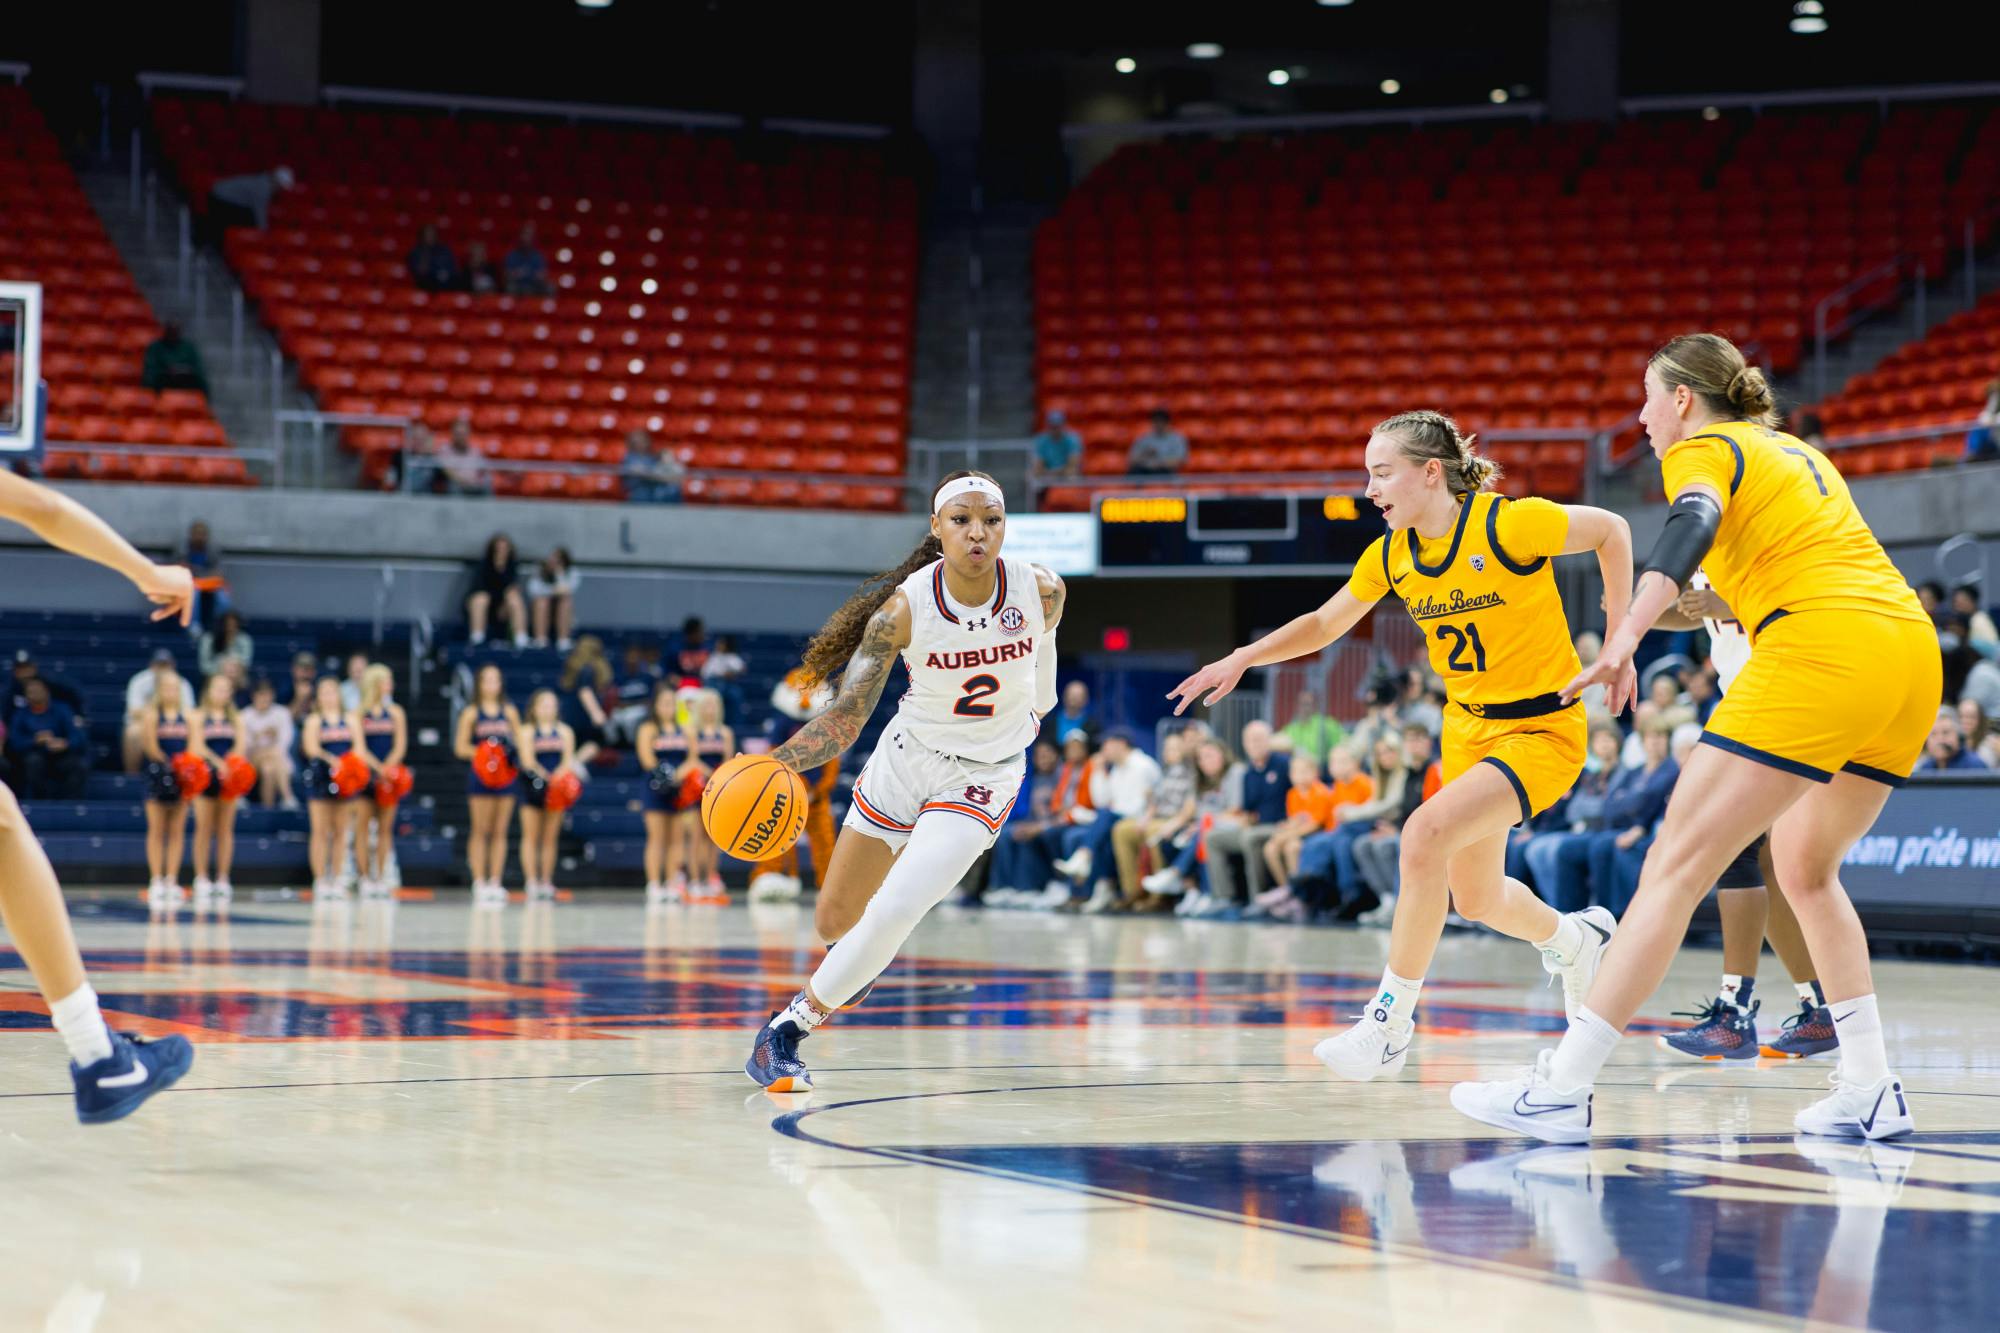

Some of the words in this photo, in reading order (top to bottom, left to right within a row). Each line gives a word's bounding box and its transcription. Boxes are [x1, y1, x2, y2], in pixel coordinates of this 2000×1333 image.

[1780, 447, 1828, 496] 7
[1449, 588, 1501, 611] Bears
[926, 637, 1033, 670] AUBURN
[1436, 622, 1486, 672] 21
[953, 673, 1001, 717] 2
[739, 793, 787, 855] Wilson
[1894, 826, 1968, 874] pride
